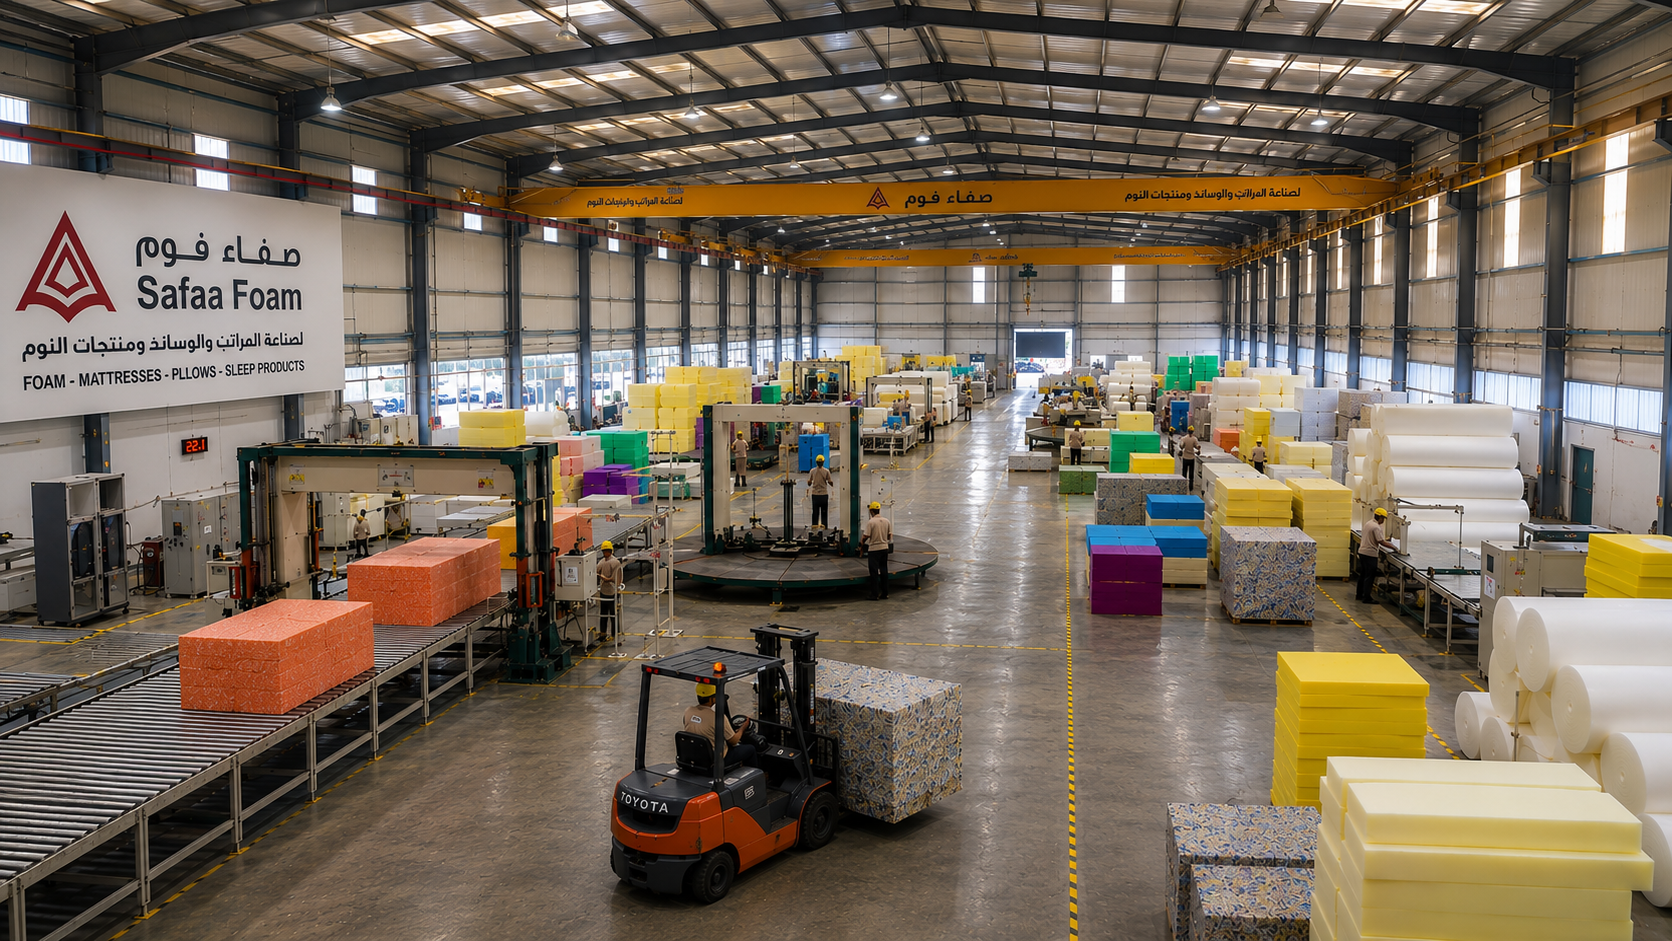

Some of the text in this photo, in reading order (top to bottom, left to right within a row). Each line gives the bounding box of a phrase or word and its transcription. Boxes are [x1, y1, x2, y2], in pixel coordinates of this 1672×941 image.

[905, 190, 993, 209] صفاء فوم
[1125, 190, 1149, 202] النوم
[1269, 187, 1301, 197] لصناعة
[136, 232, 301, 267] صفاء فوم
[137, 275, 302, 310] Safaa Foam
[22, 336, 68, 362] النوم
[73, 336, 145, 357] ومنتجات
[264, 331, 303, 346] لصناعة
[23, 374, 66, 391] FOAM
[79, 368, 162, 387] MATTRESSES
[172, 365, 216, 380] PLLOWS
[225, 363, 256, 377] SLEEP
[258, 360, 305, 374] PRODUCTS
[186, 439, 205, 453] 22.1
[621, 791, 668, 813] TOYOTA
